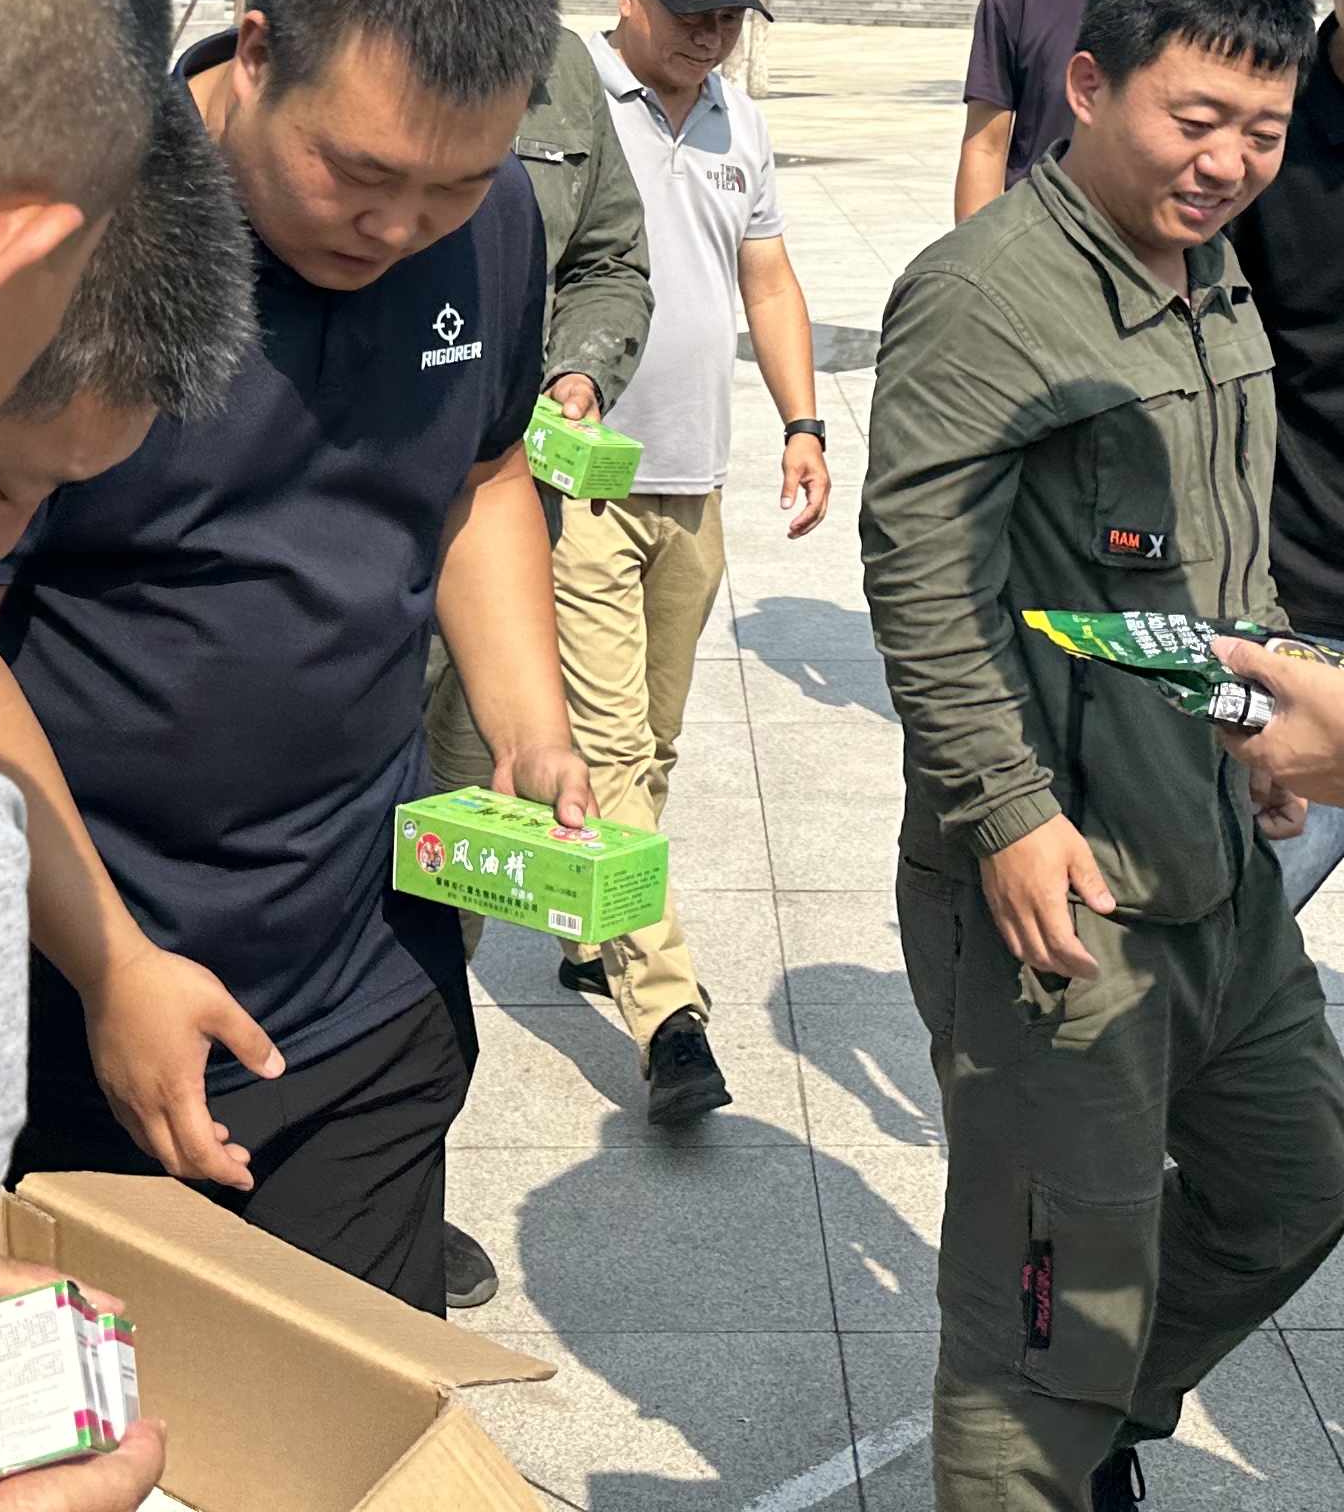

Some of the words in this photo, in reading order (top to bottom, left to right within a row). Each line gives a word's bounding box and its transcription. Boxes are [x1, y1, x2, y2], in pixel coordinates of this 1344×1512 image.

[421, 341, 483, 371] RIGORER
[1109, 529, 1141, 549] RAM
[1145, 533, 1165, 558] X
[451, 838, 527, 888] 风油精
